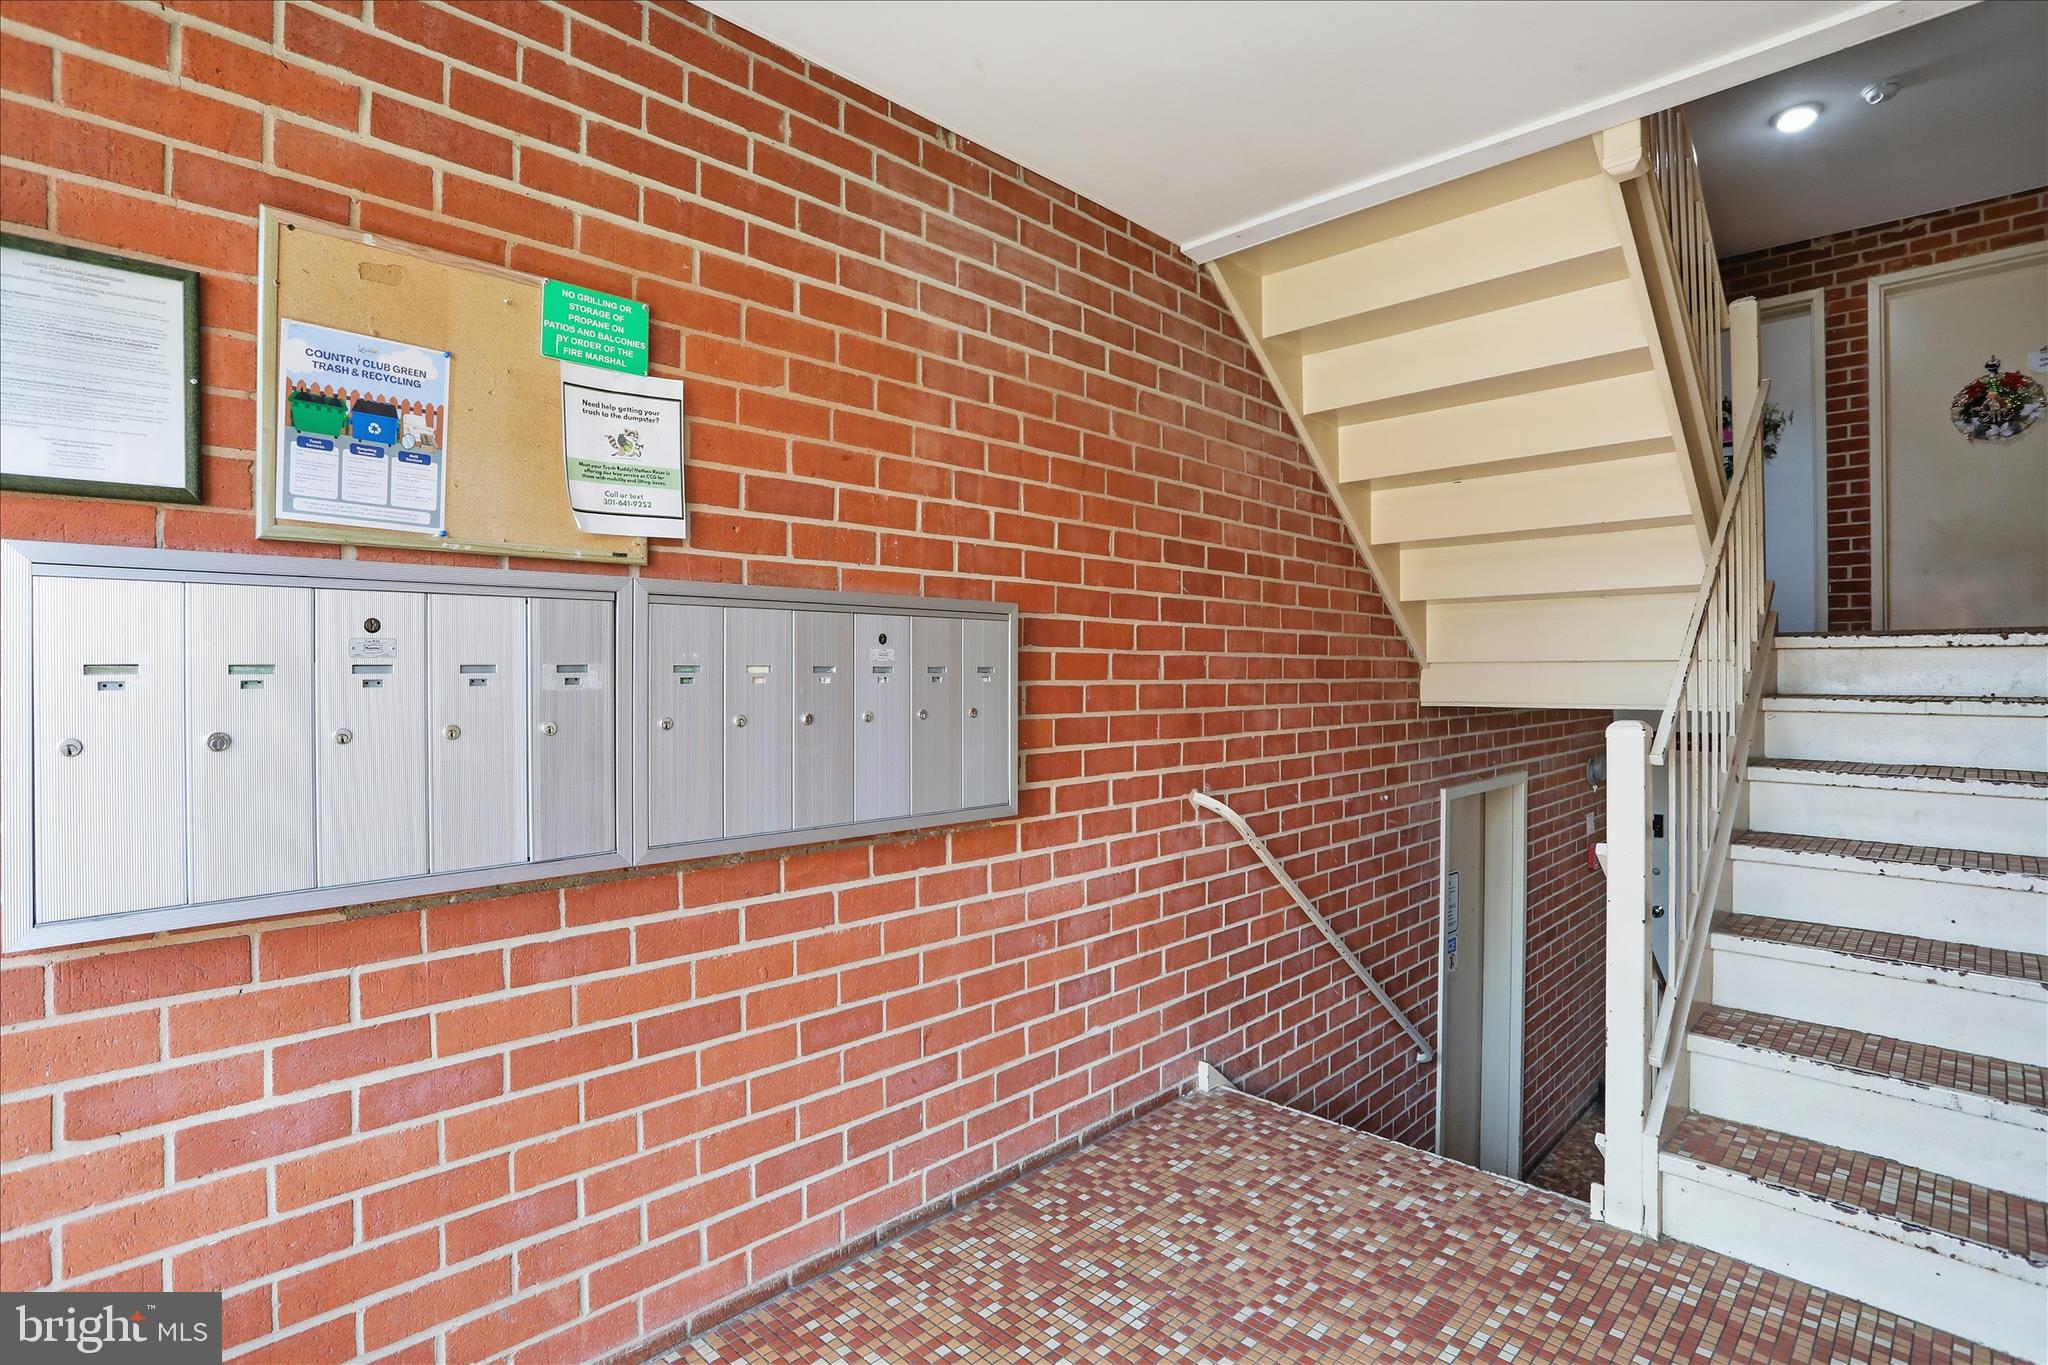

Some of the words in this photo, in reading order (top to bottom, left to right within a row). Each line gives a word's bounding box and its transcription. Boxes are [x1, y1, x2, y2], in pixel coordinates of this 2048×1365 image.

[561, 289, 575, 299] NO
[577, 293, 617, 310] GRILLING
[619, 305, 632, 314] OR
[569, 303, 611, 320] STORAGE
[612, 313, 624, 322] OF
[568, 313, 610, 330] PROPANE
[612, 324, 624, 333] ON
[543, 319, 575, 333] PATIOS
[577, 328, 595, 338] AND
[597, 331, 645, 350] BALCONIES
[557, 334, 568, 343] BY
[570, 337, 601, 350] ORDER
[603, 344, 615, 353] OF
[618, 347, 633, 358] THE
[305, 347, 360, 366] COUNTRY
[362, 359, 391, 372] CLUB
[392, 364, 427, 379] GREEN
[563, 347, 583, 358] FIRE
[585, 351, 627, 367] MARSHAL
[312, 360, 349, 375] TRASH
[351, 368, 359, 377] &
[361, 370, 421, 388] RECYCLING
[582, 399, 600, 409] Need
[601, 403, 616, 412] help
[618, 406, 642, 416] getting
[582, 408, 600, 416] trash
[623, 414, 660, 424] dumpster?
[603, 498, 652, 508] 301-641-9252
[604, 490, 619, 498] Call
